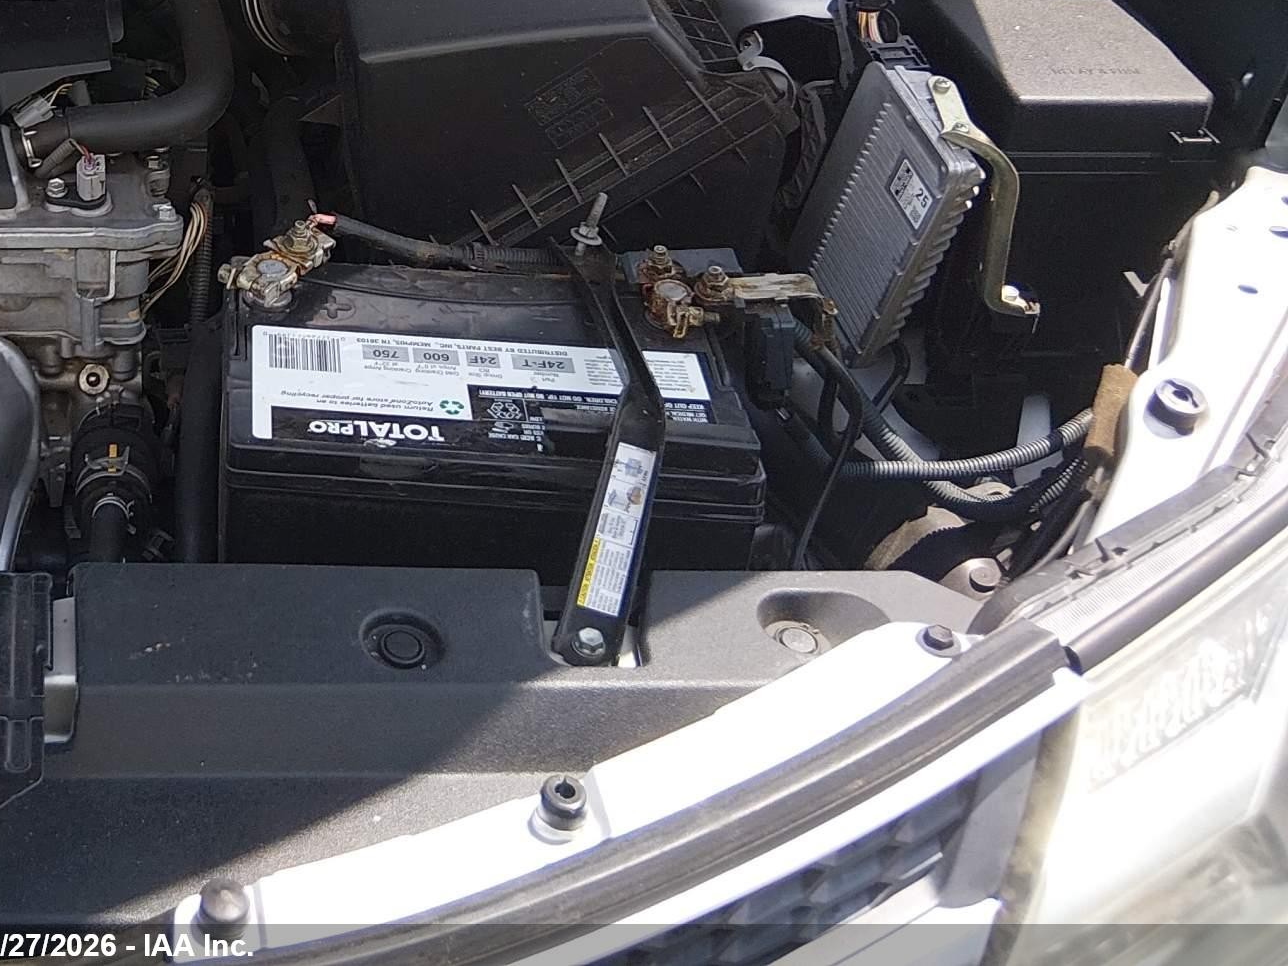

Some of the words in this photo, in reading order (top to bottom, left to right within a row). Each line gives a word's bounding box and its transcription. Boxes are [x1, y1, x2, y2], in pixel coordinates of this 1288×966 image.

[915, 187, 929, 208] 25
[372, 349, 400, 358] 750
[423, 352, 450, 362] 600
[517, 348, 568, 356] DISTRIBUTED
[468, 355, 497, 365] 24F
[521, 358, 565, 370] 24F-T
[404, 404, 434, 412] Return
[307, 420, 445, 442] TOTALPRO
